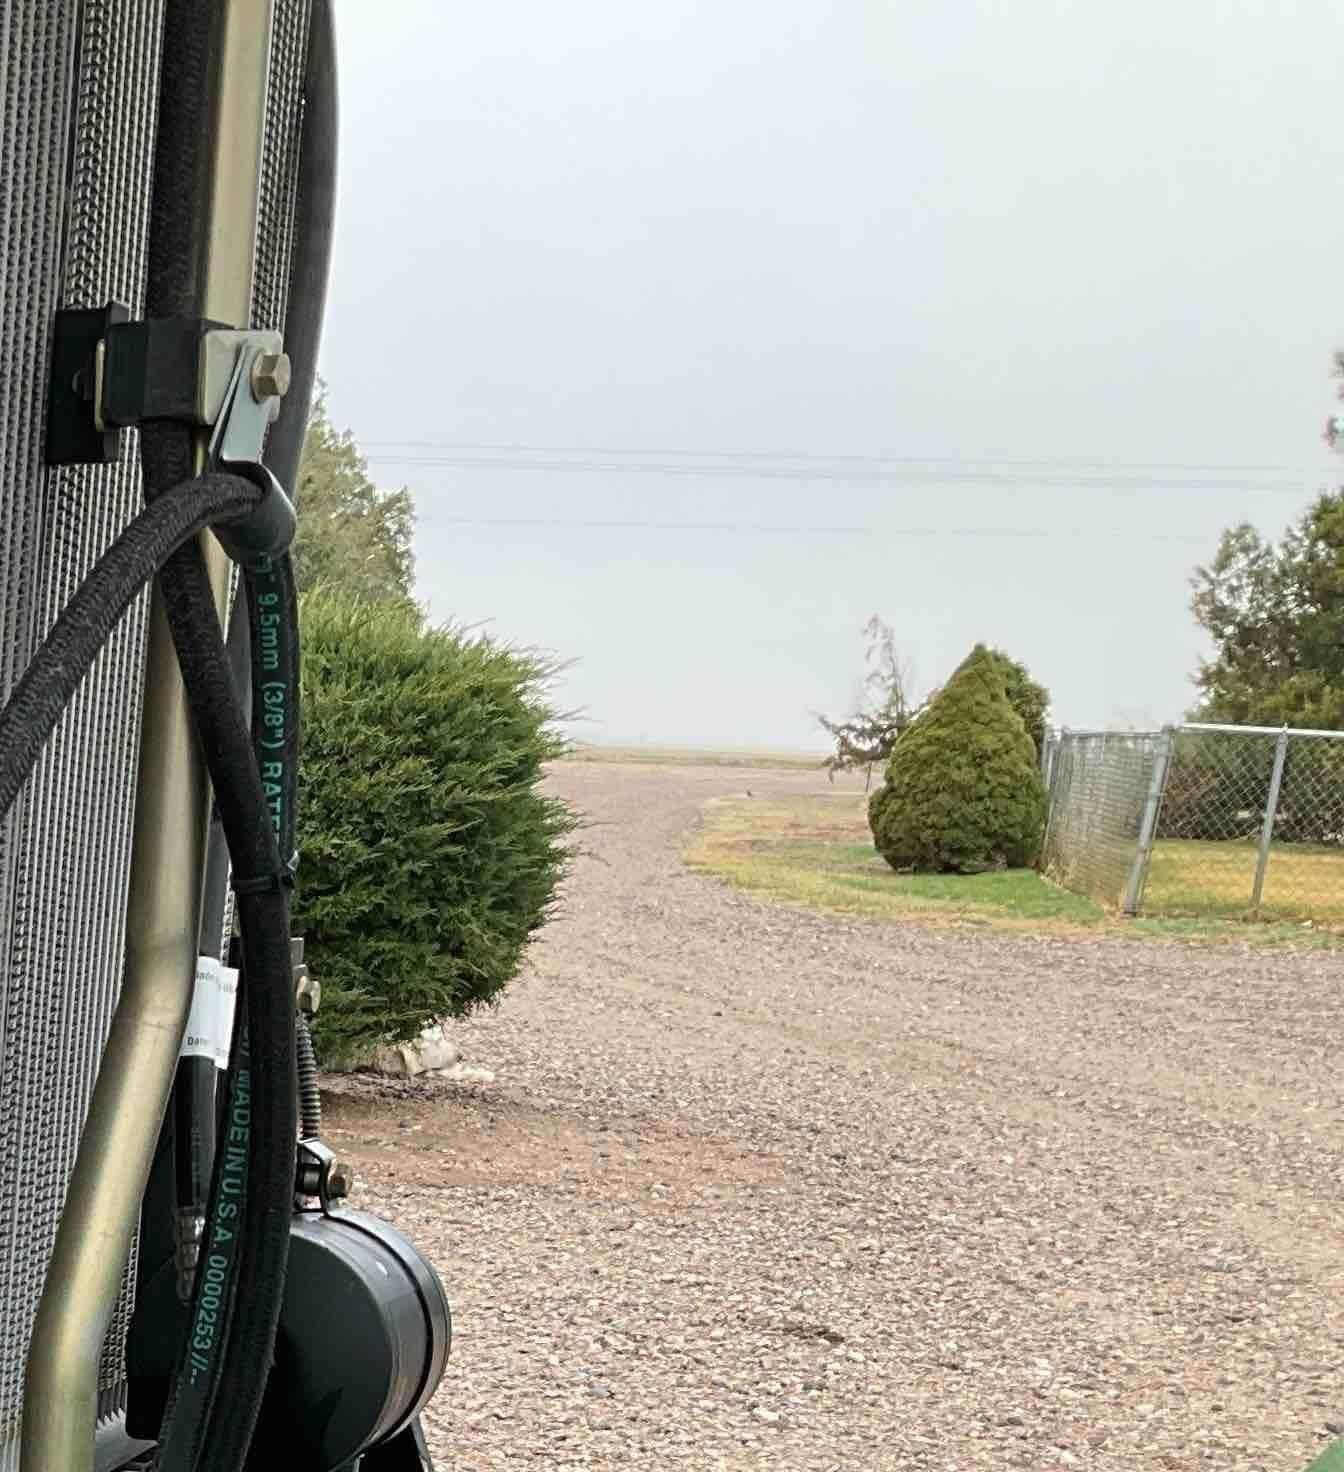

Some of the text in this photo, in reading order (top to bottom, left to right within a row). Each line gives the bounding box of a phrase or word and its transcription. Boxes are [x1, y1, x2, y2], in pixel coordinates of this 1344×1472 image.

[257, 592, 281, 670] 9.5mm
[261, 681, 287, 749] (3/8")
[230, 1070, 250, 1142] MADE
[224, 1146, 247, 1171] IN
[213, 1177, 242, 1249] U.S.A.
[193, 1255, 228, 1350] 0000253
